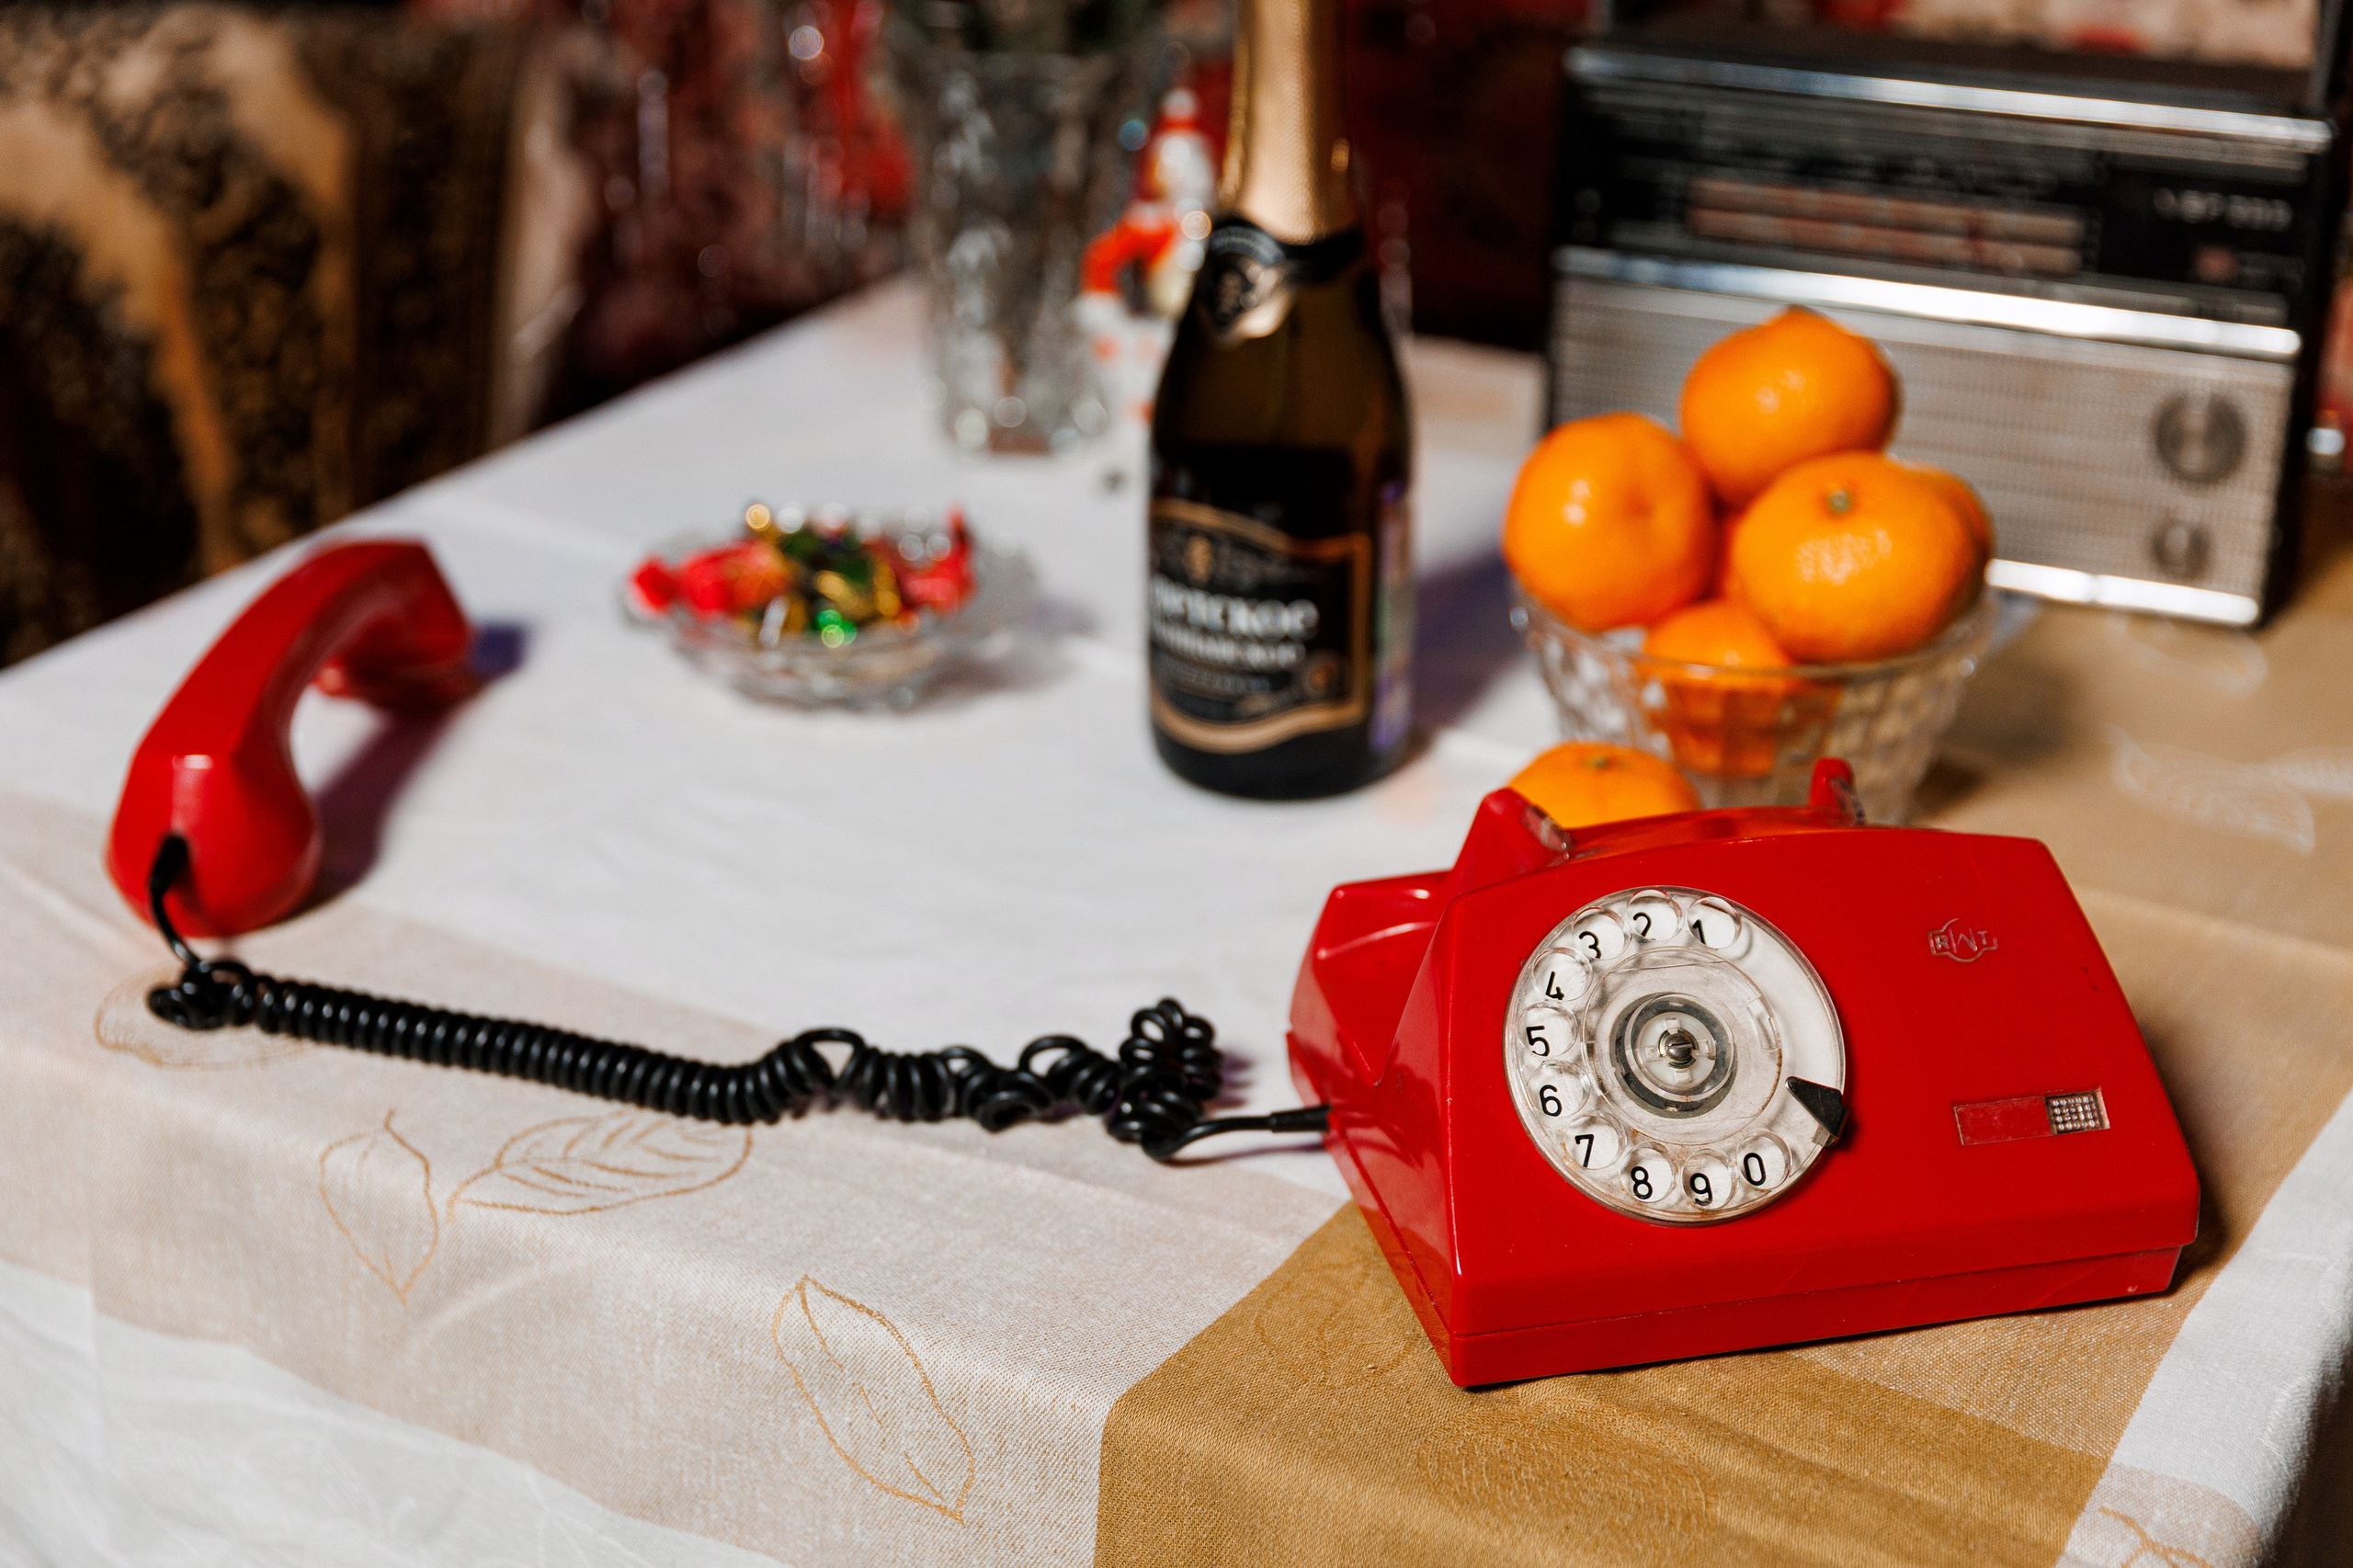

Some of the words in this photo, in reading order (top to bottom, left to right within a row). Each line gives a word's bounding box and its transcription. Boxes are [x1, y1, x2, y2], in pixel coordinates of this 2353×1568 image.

[1632, 912, 1652, 938] 2
[1692, 919, 1707, 945] 1
[1578, 930, 1601, 959] 3
[1545, 971, 1564, 1000] 4
[1525, 1025, 1550, 1057] 5
[1539, 1085, 1563, 1118] 6
[1574, 1133, 1595, 1168] 7
[1630, 1165, 1654, 1200] 8
[1743, 1152, 1767, 1187] 0
[1688, 1172, 1713, 1207] 9
